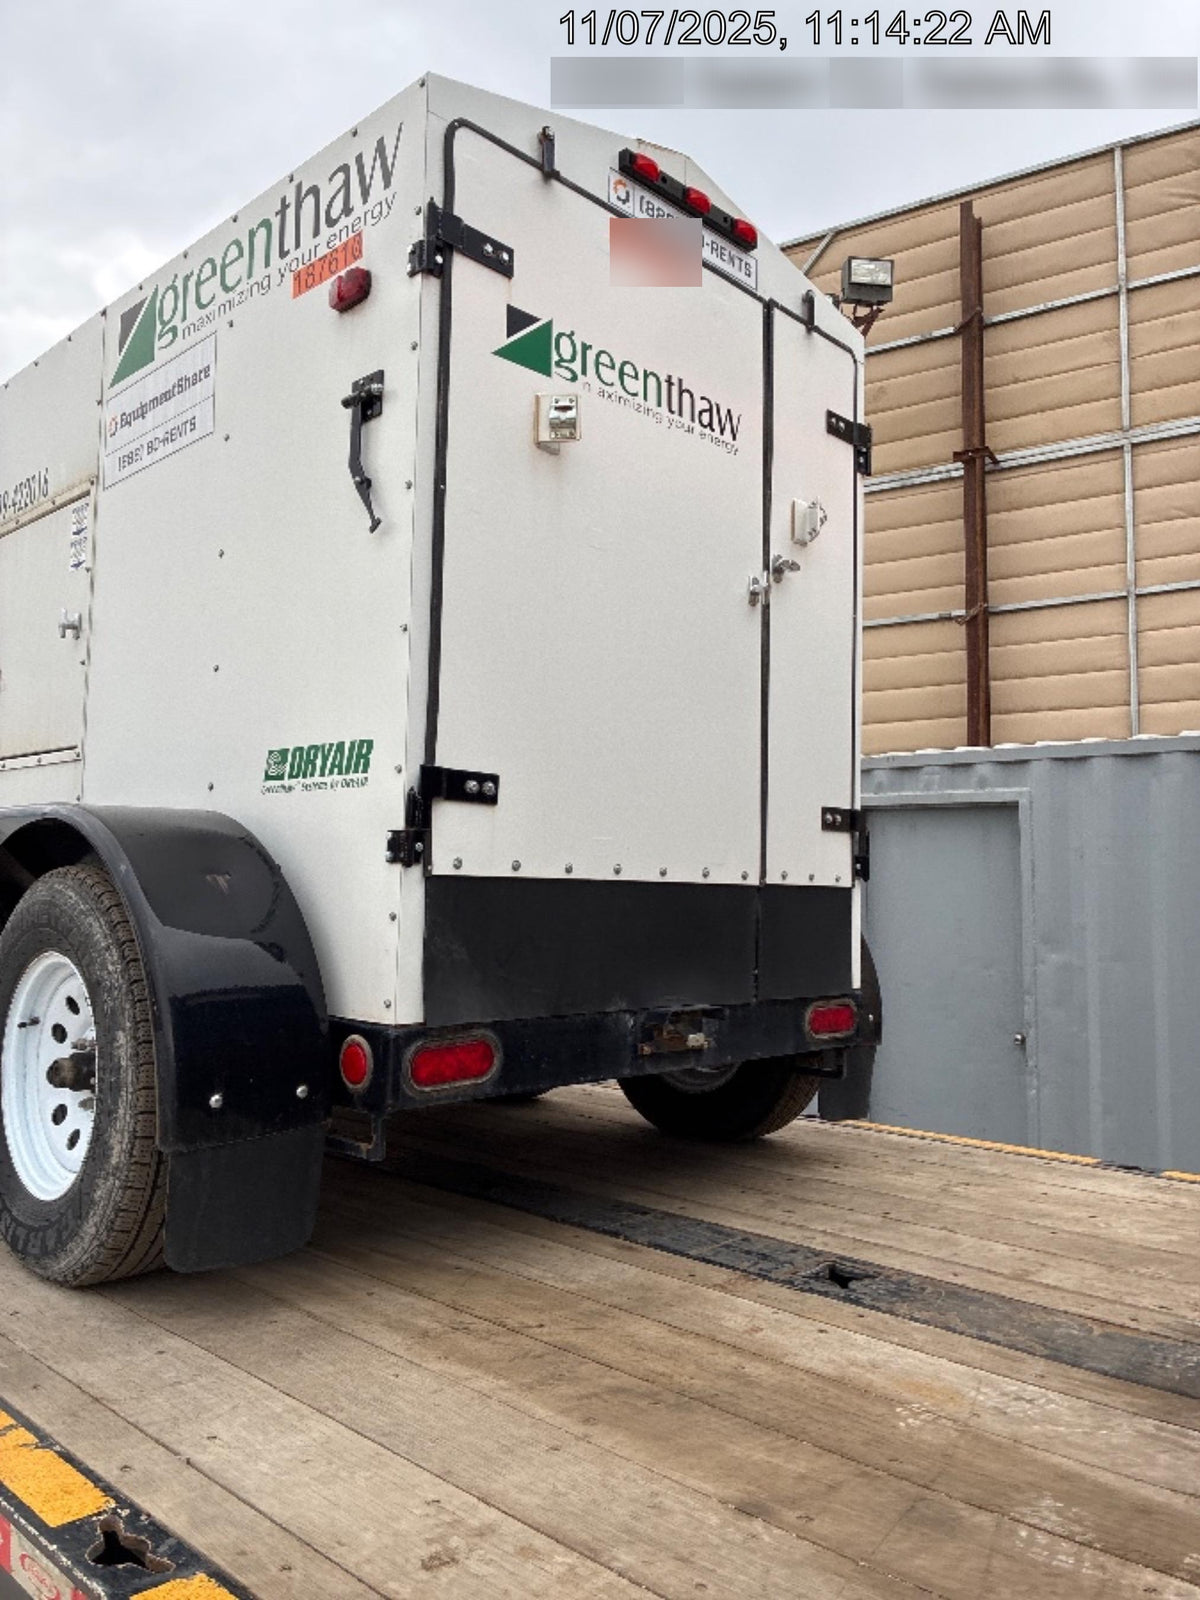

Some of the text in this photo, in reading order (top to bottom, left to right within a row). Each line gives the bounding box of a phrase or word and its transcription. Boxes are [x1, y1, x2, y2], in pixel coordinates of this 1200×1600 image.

[157, 122, 403, 350] greenthaw
[182, 191, 397, 340] maximizing your energy
[120, 364, 211, 429] EquipmentShare
[554, 330, 742, 441] greenthaw
[287, 739, 374, 780] DRYAIR
